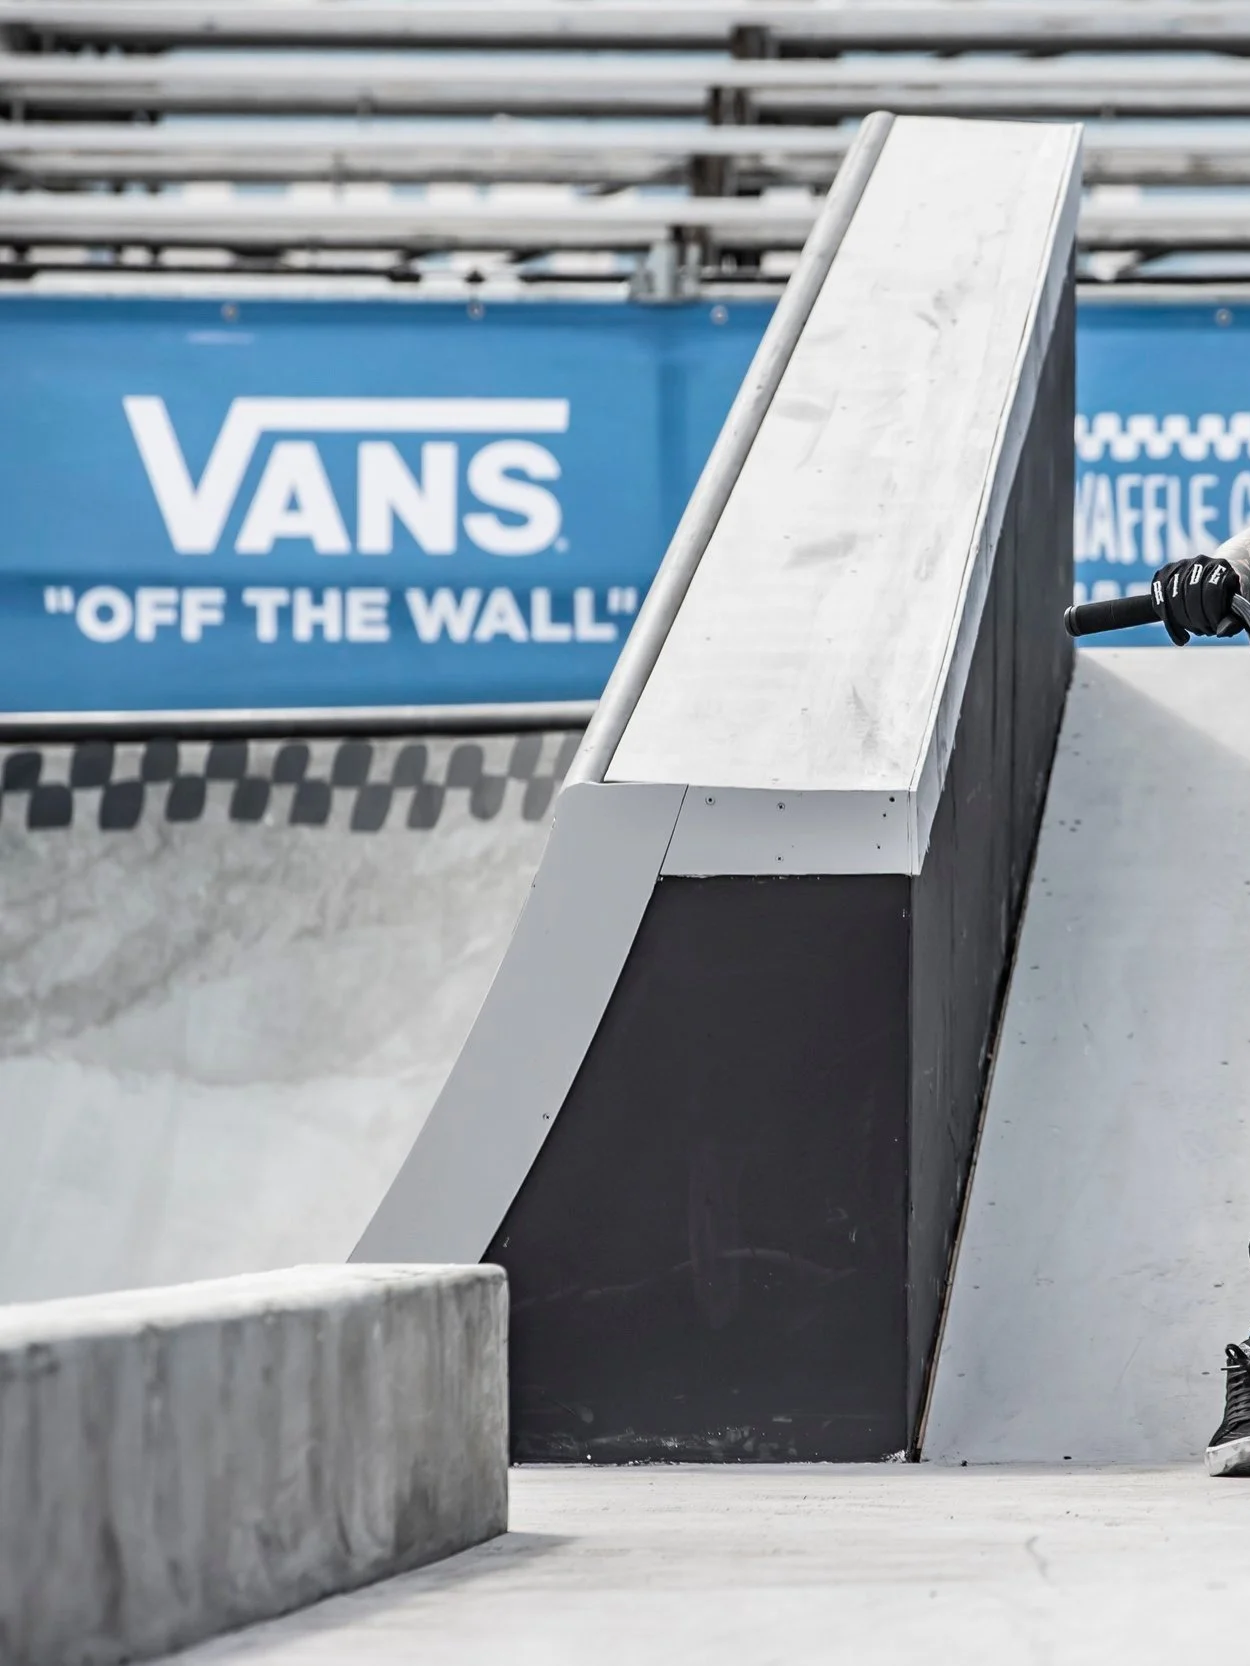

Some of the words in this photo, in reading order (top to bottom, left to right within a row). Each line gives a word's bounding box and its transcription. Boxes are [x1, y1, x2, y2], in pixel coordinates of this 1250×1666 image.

[122, 395, 570, 556] VANS
[1153, 564, 1227, 605] RIDE
[44, 586, 225, 643] "OFF
[243, 587, 390, 643] THE
[407, 587, 638, 643] WALL"
